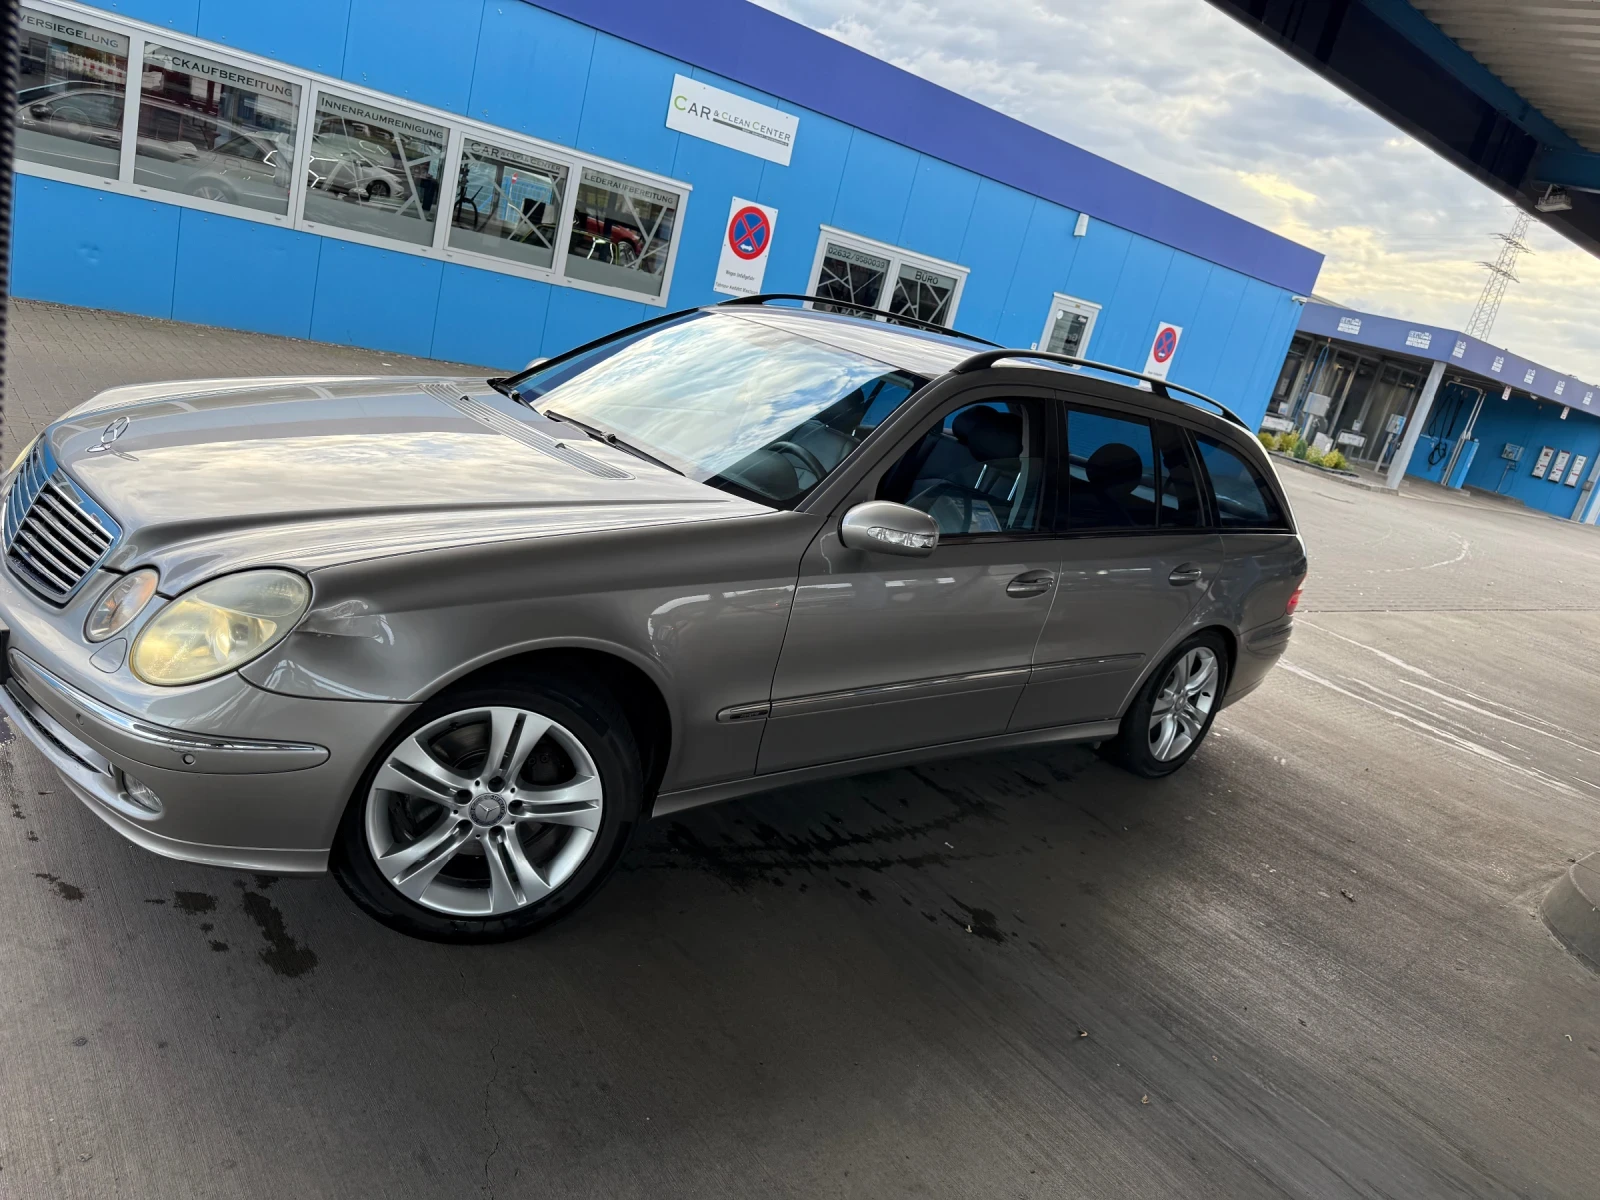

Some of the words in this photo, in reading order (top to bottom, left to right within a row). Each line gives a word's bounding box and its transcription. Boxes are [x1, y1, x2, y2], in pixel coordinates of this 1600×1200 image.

[321, 97, 444, 139] INNENRAUMREINIGUNG
[674, 95, 711, 120] CAR
[713, 109, 720, 118] &
[721, 111, 751, 128] CLEAN
[752, 121, 791, 142] CENTER
[471, 142, 500, 158] CAR
[584, 172, 673, 204] LEDERAUFBEREITUNG
[915, 270, 939, 285] BÜRO
